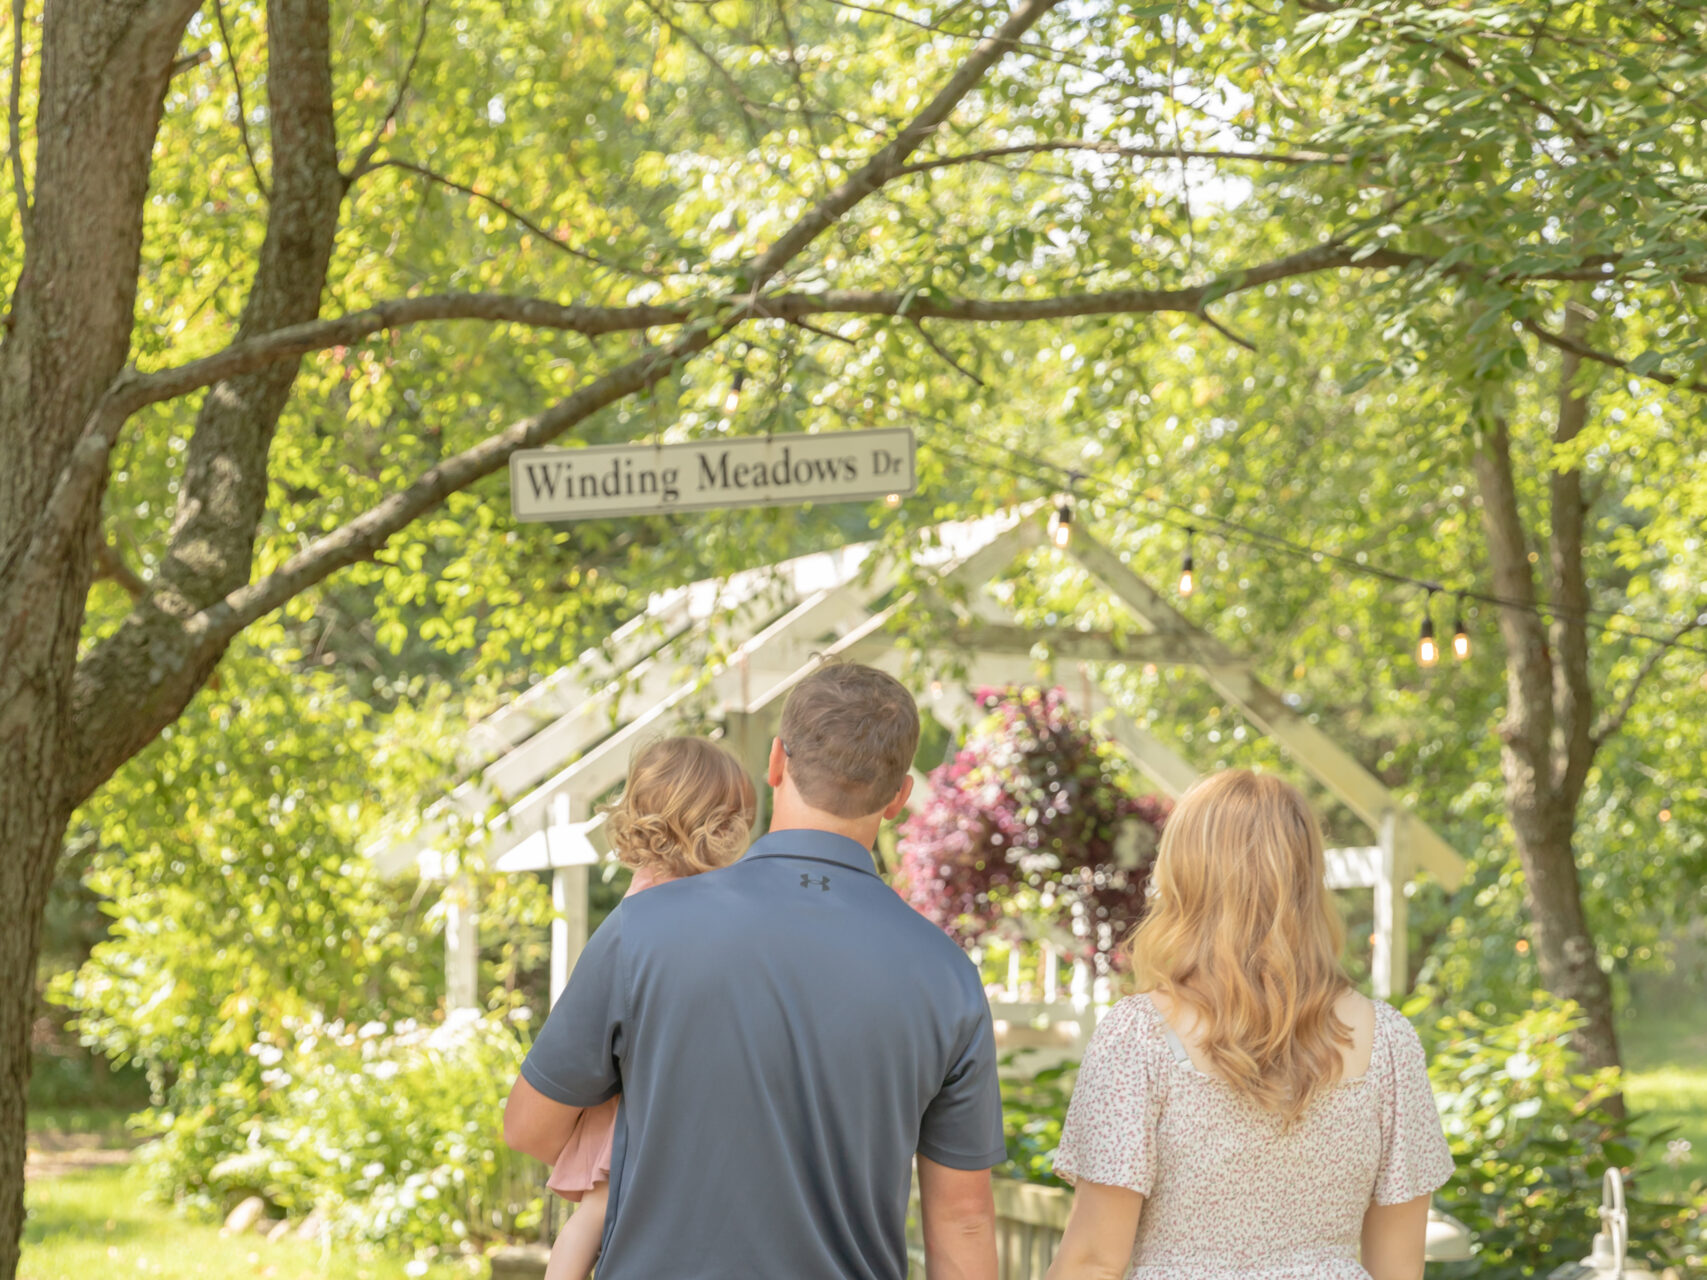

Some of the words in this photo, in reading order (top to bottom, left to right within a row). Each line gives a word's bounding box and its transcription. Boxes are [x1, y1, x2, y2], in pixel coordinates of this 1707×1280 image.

[525, 458, 680, 501] Winding
[698, 447, 858, 491] Meadows
[872, 449, 903, 476] Dr
